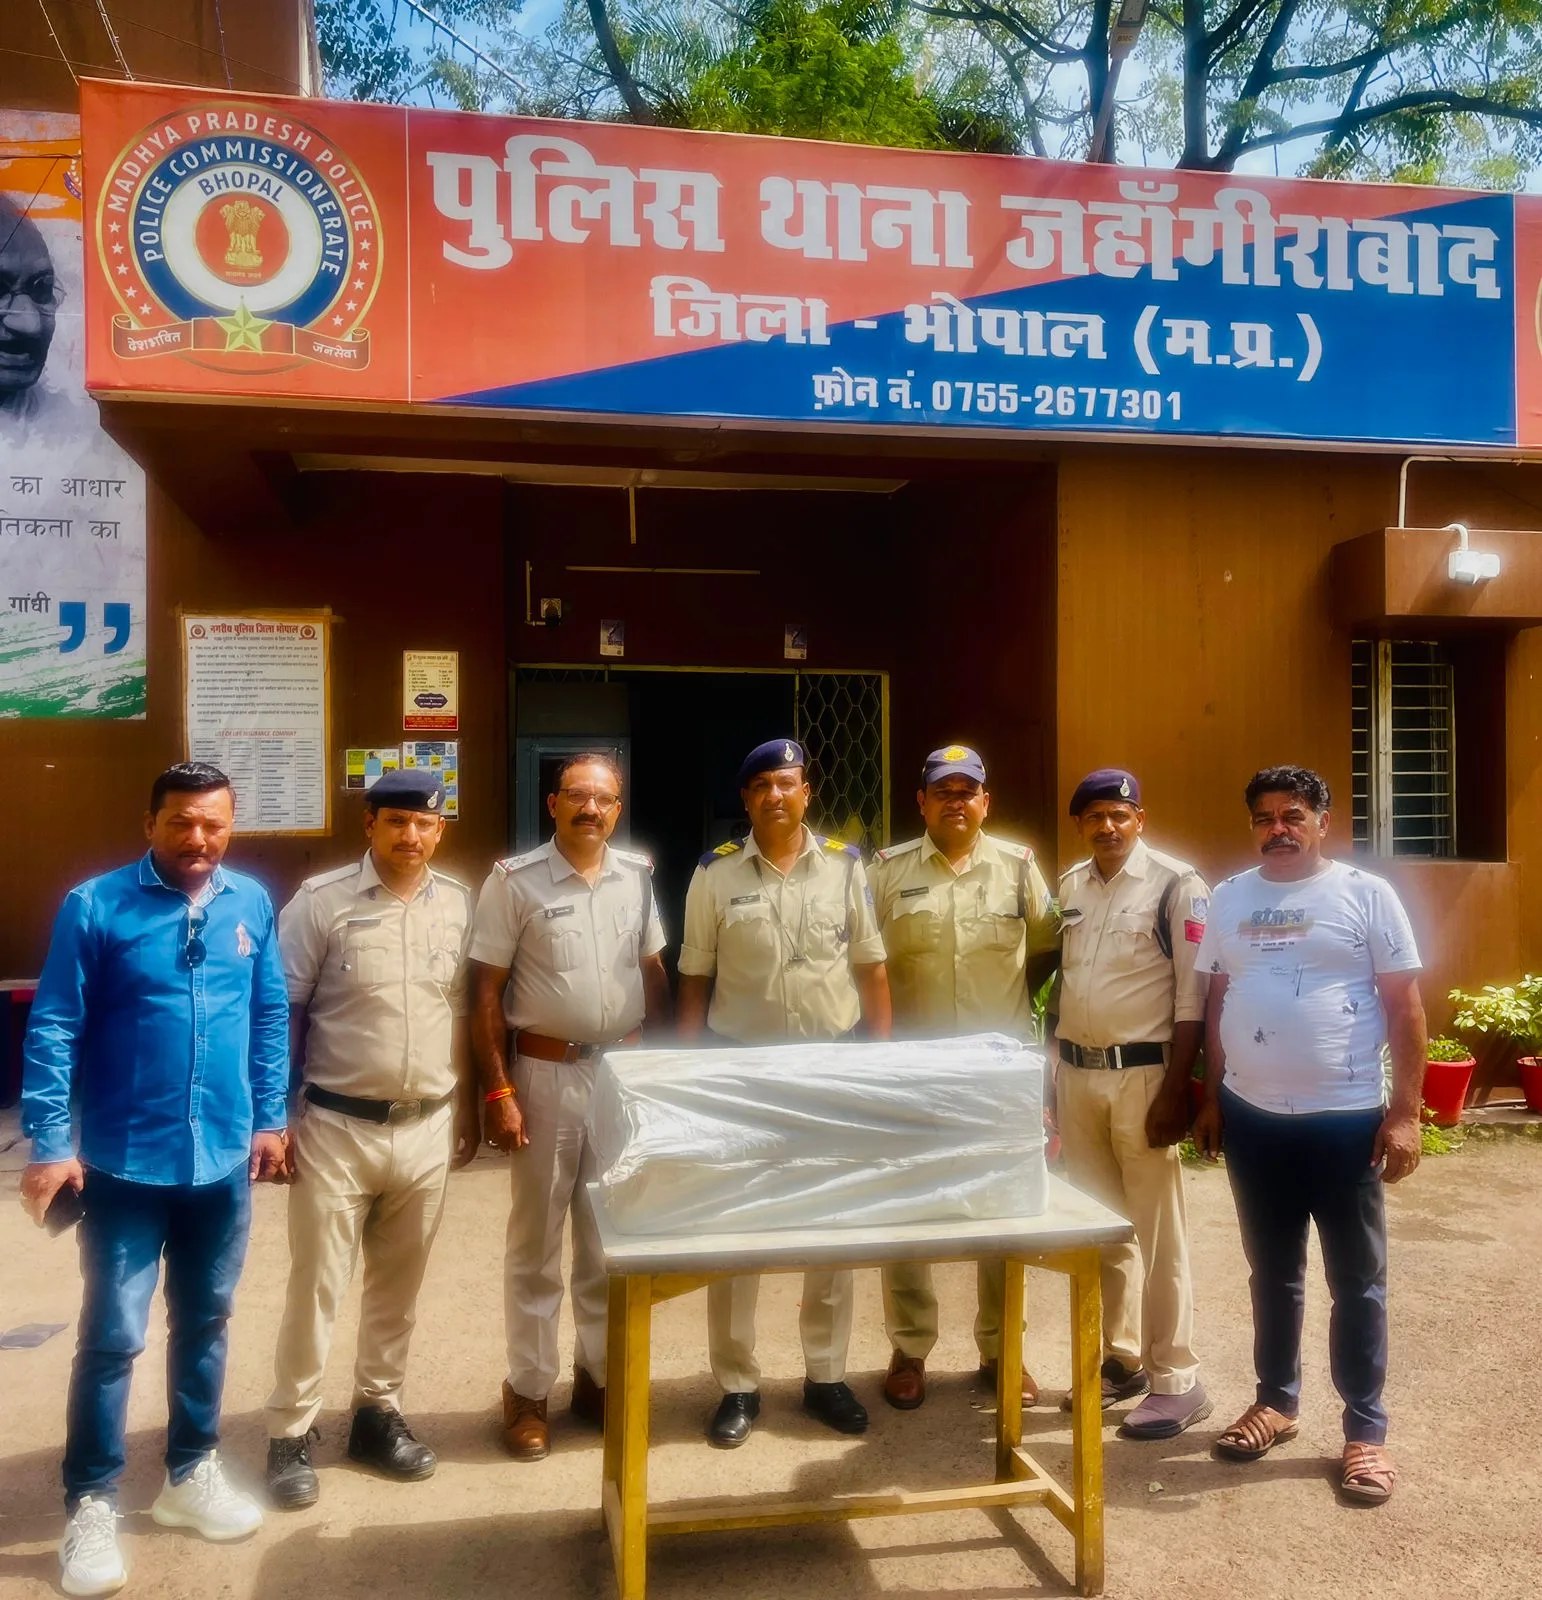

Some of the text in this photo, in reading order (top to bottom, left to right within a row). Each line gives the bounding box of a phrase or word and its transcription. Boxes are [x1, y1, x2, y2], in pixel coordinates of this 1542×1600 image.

[107, 111, 373, 232] MADHYA PRADESH POLICE
[197, 170, 286, 203] BHOPAL
[140, 140, 345, 276] POLICE COMMISSIONERATE
[426, 133, 725, 270] पुलिस
[759, 175, 974, 268] थाना
[649, 274, 831, 346] जिला
[903, 291, 1108, 360] भोपाल
[312, 341, 357, 360] जनसेवा
[812, 367, 879, 410] फ़ोन
[932, 381, 1182, 421] 0755-2677301
[9, 476, 127, 500] का आधार
[88, 520, 121, 540] का
[8, 591, 51, 614] गांधी
